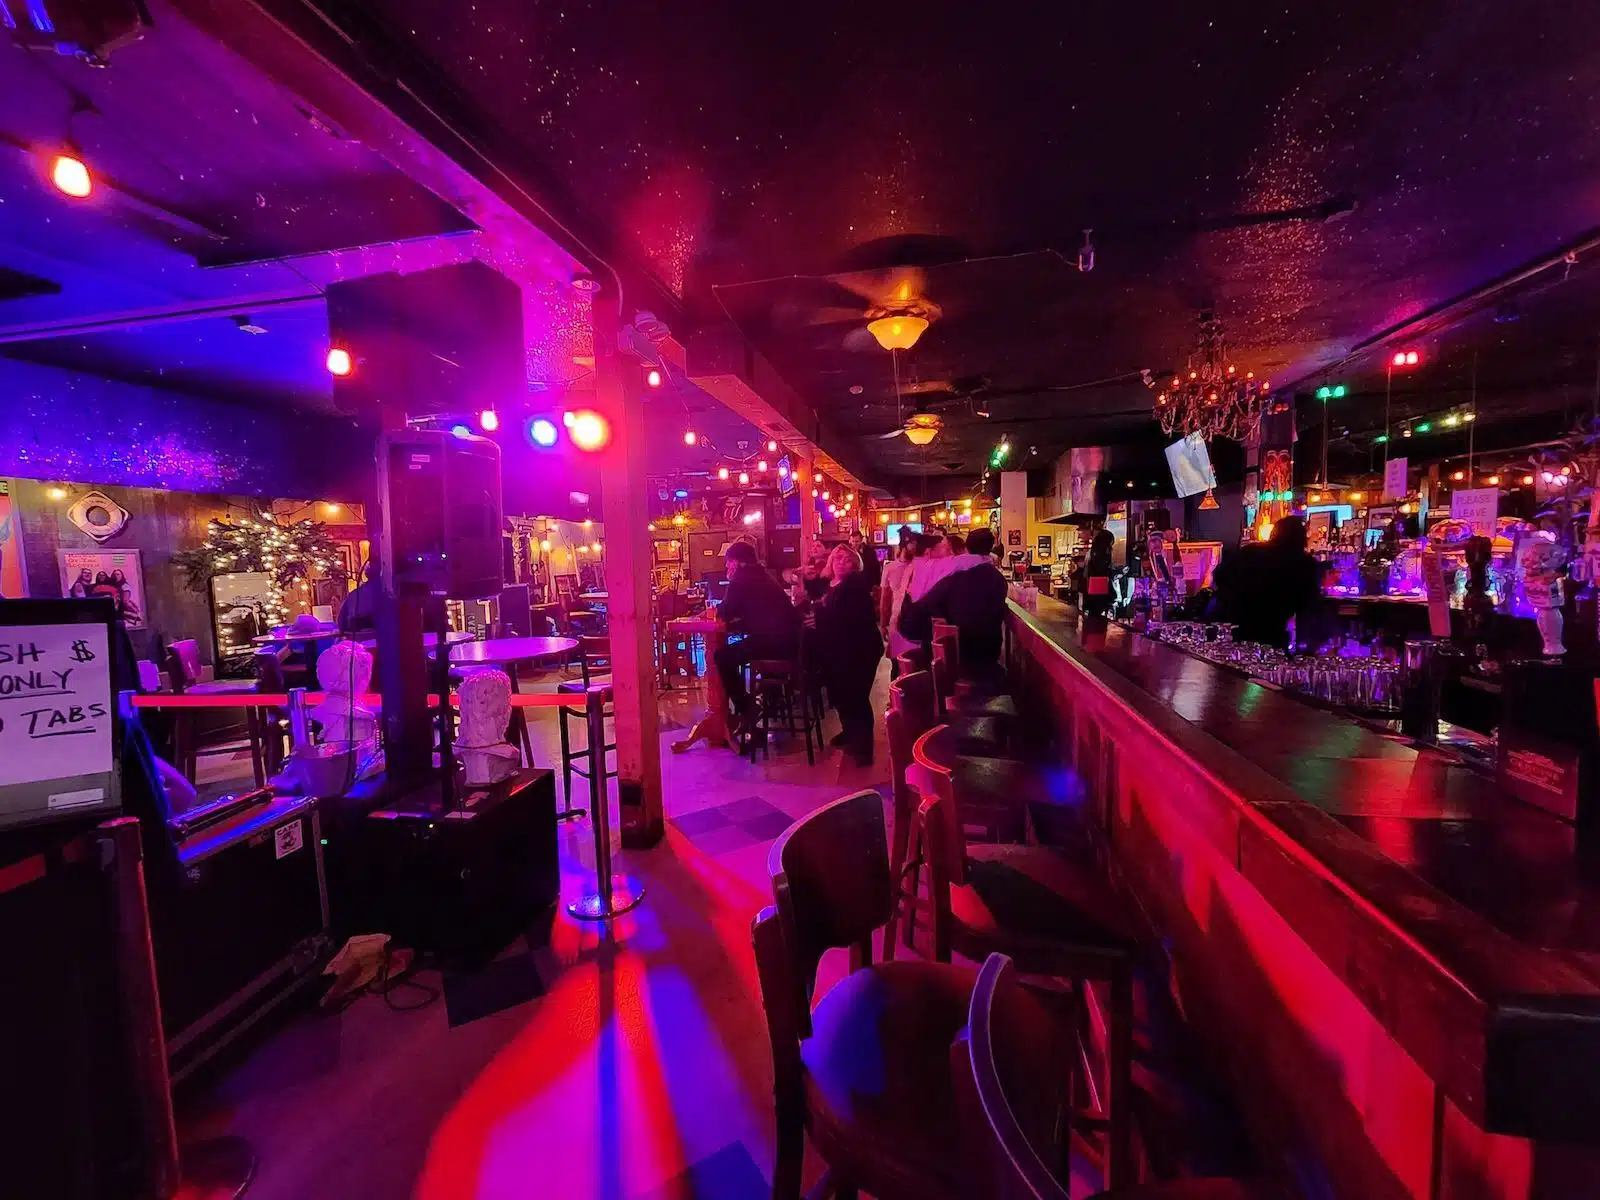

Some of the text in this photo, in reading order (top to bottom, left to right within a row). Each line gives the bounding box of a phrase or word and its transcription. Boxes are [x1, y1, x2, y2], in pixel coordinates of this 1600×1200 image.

[1456, 494, 1491, 505] PLEASE
[1458, 507, 1487, 517] LEAVE
[0, 639, 96, 664] SH $
[0, 668, 74, 695] ONLY
[20, 703, 107, 734] TABS
